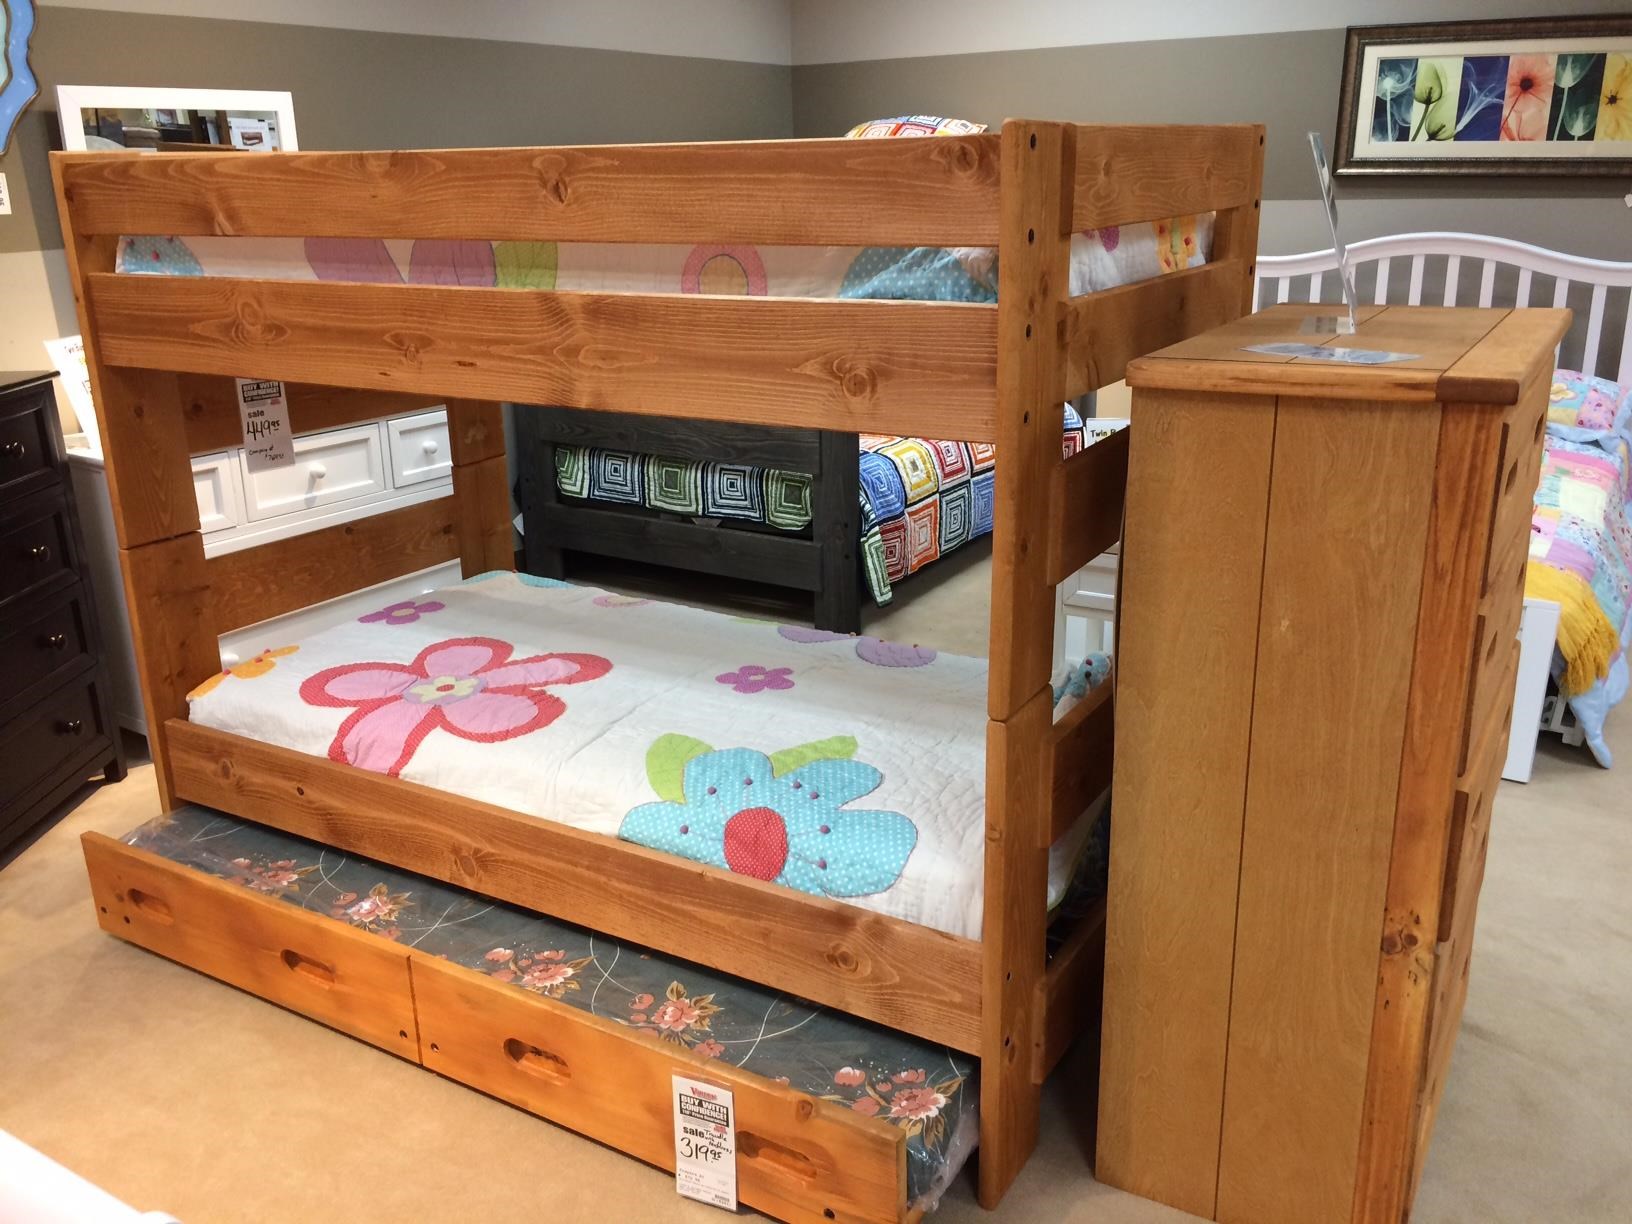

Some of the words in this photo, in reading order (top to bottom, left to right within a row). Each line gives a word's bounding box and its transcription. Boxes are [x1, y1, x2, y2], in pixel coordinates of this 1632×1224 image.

[248, 409, 265, 418] sale
[1090, 429, 1108, 438] Twin
[681, 1095, 699, 1105] BUY
[702, 1100, 727, 1114] WITH
[681, 1103, 727, 1121] CONFIDENCE!
[683, 1126, 705, 1139] sale
